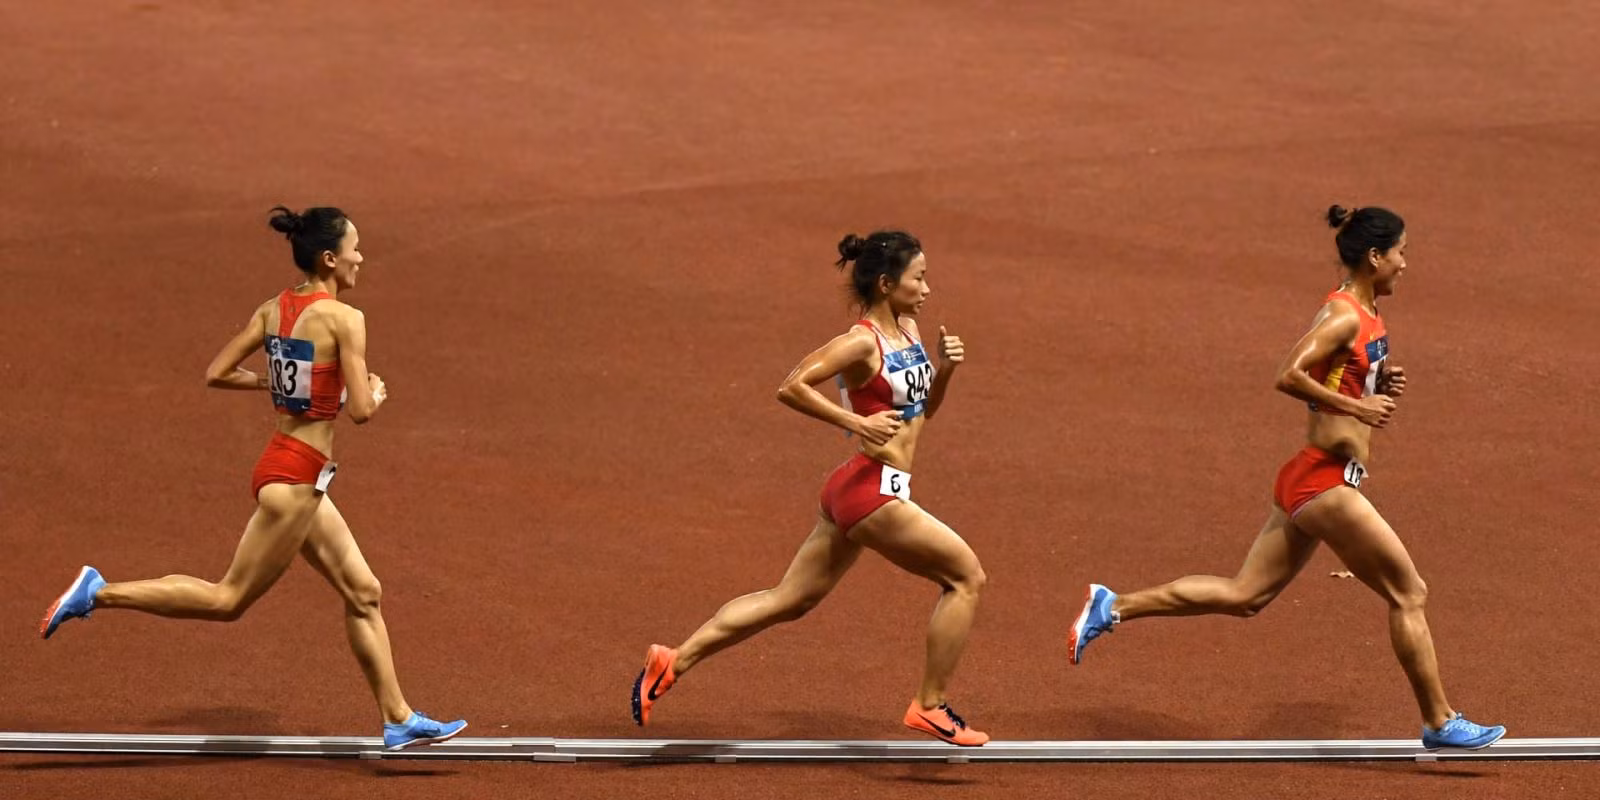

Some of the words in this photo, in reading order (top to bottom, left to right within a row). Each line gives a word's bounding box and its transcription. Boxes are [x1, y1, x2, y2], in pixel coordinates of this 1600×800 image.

[269, 357, 298, 396] 183
[905, 363, 933, 404] 843
[890, 473, 901, 494] 6
